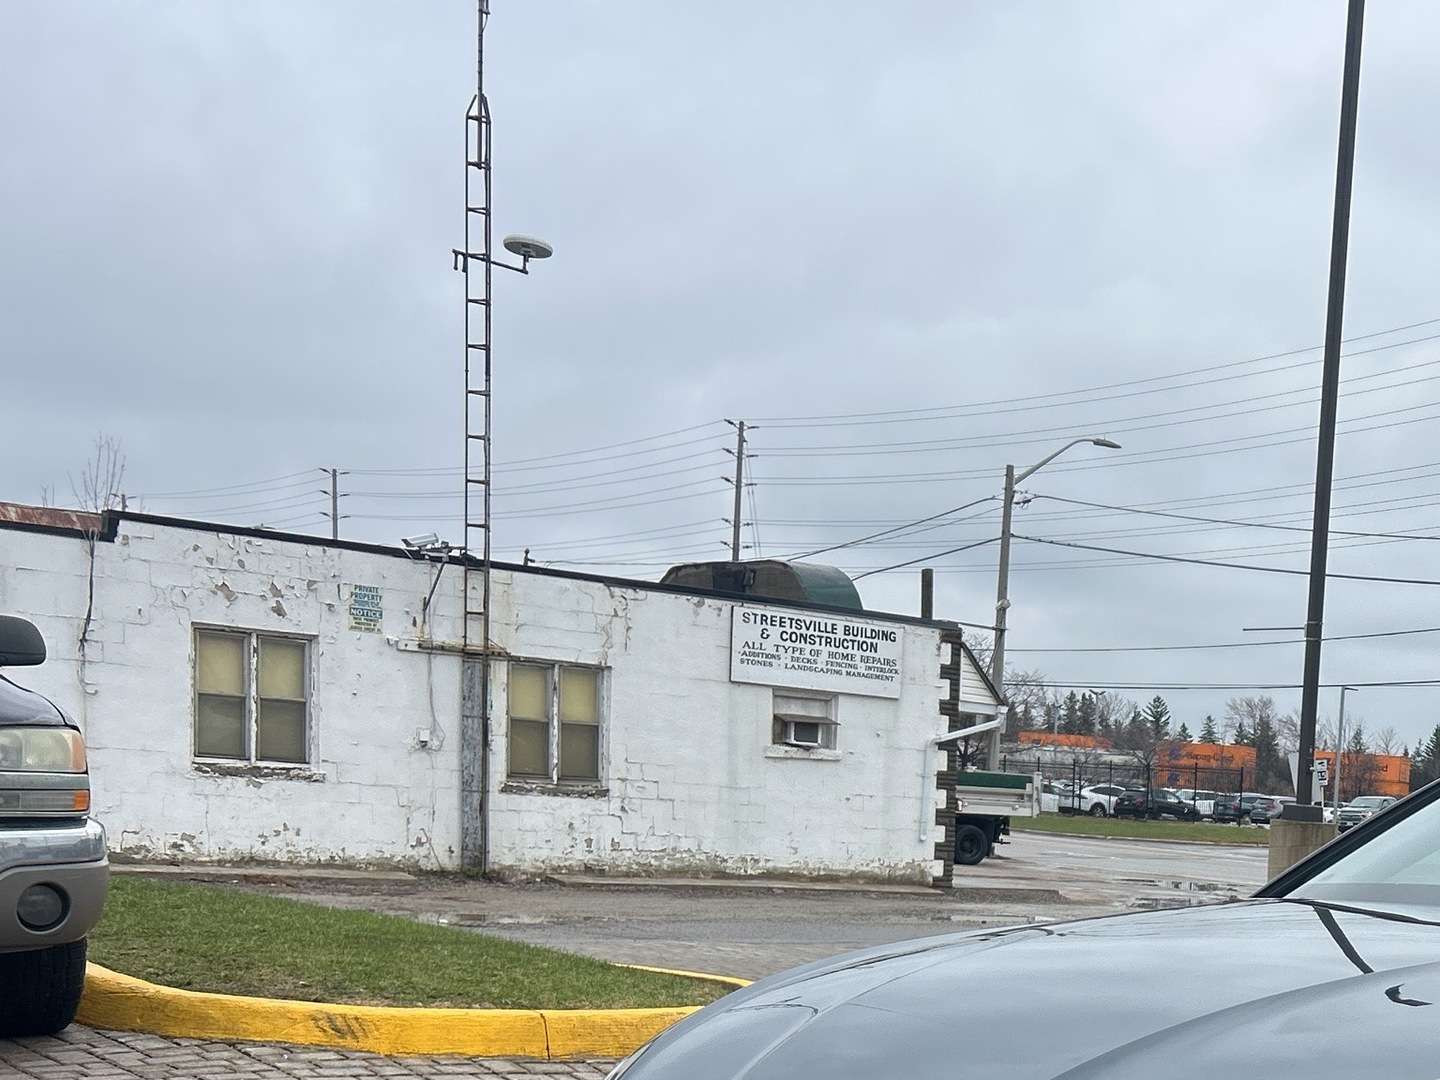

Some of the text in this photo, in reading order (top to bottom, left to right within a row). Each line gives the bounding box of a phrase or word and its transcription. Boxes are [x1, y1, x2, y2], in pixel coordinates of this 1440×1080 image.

[350, 607, 382, 619] NOTICE
[742, 611, 897, 643] STREETSVILLE BUILDING
[760, 627, 878, 654] & CONSTRUCTION
[742, 640, 897, 668] ALL TYPE OF HOME REPAIRS
[790, 655, 819, 665] DECKS
[825, 660, 859, 670] FENCING
[740, 658, 896, 682] STONES LANDSCAPING MANAGEMENT
